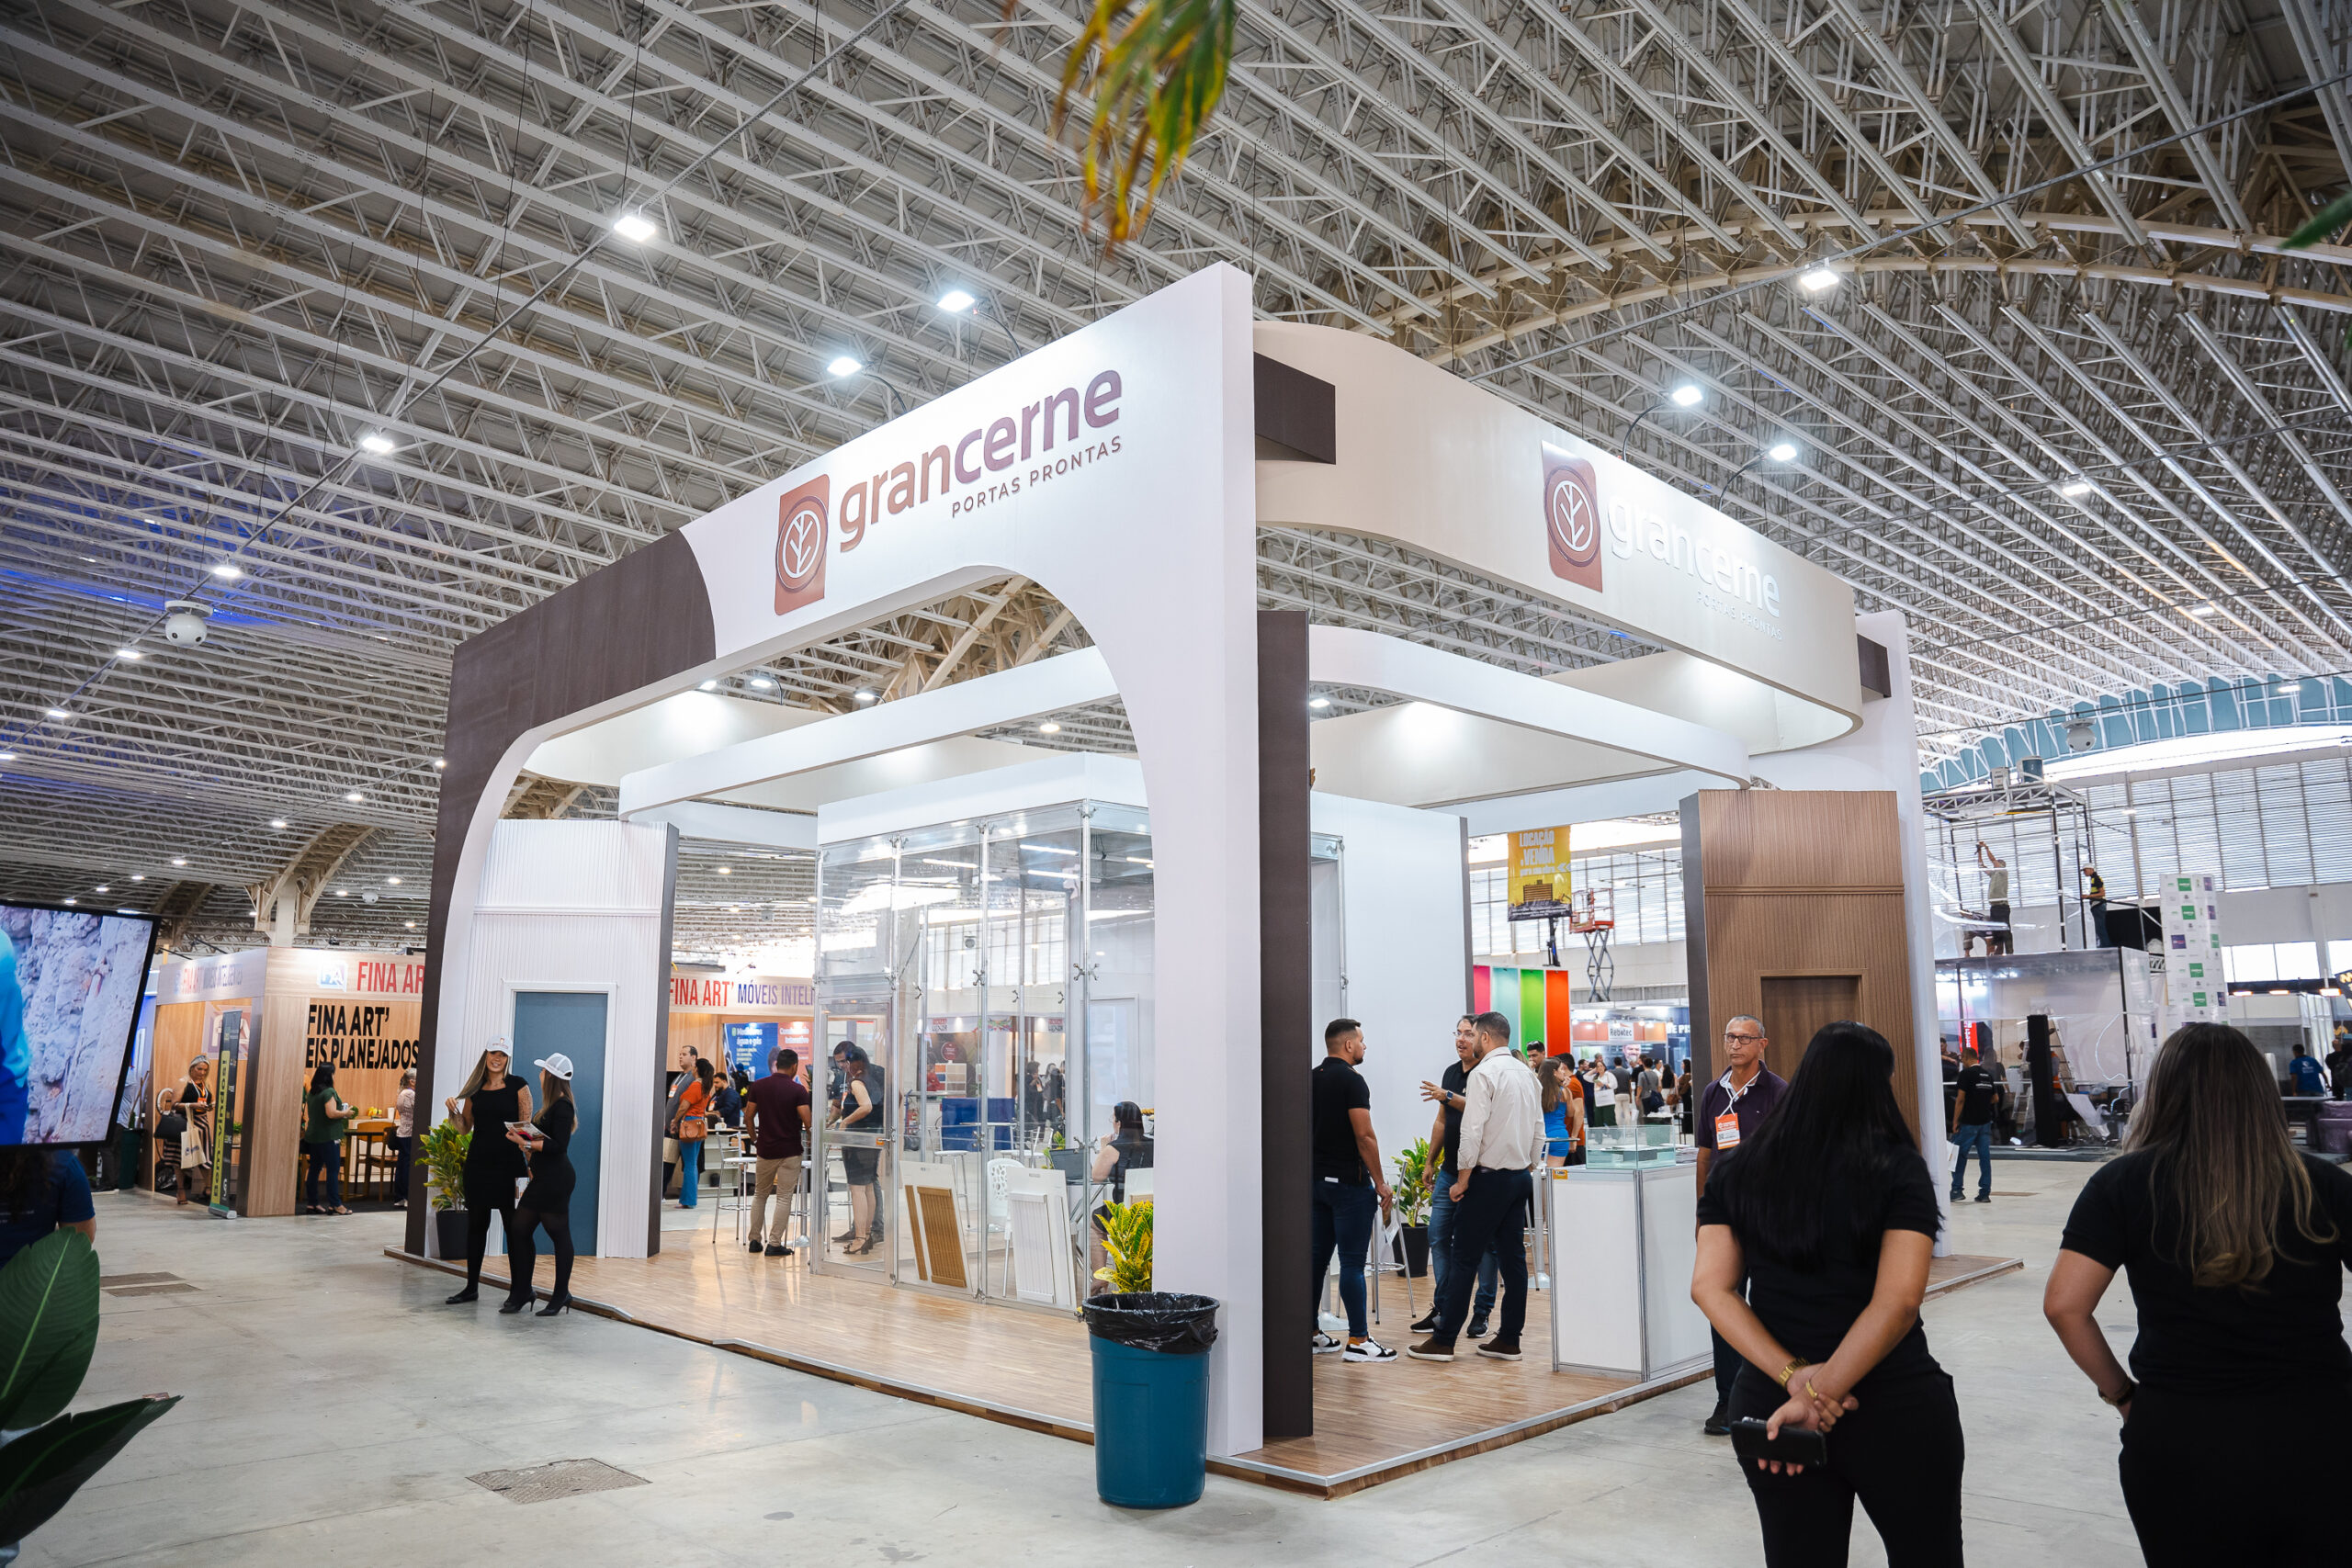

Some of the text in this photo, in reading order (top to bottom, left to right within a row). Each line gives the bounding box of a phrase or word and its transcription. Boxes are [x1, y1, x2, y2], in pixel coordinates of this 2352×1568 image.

[840, 369, 1122, 553] grancerne
[952, 435, 1122, 518] PORTAS PRONTAS
[1607, 494, 1780, 618] grancerne
[1697, 589, 1784, 641] PORTAS PRONTAS
[1523, 846, 1555, 866] VENDA
[356, 962, 397, 992] FINA
[738, 979, 777, 1005] MÓVEIS
[308, 1004, 346, 1035] FINA
[331, 1038, 419, 1070] PLANEJADOS
